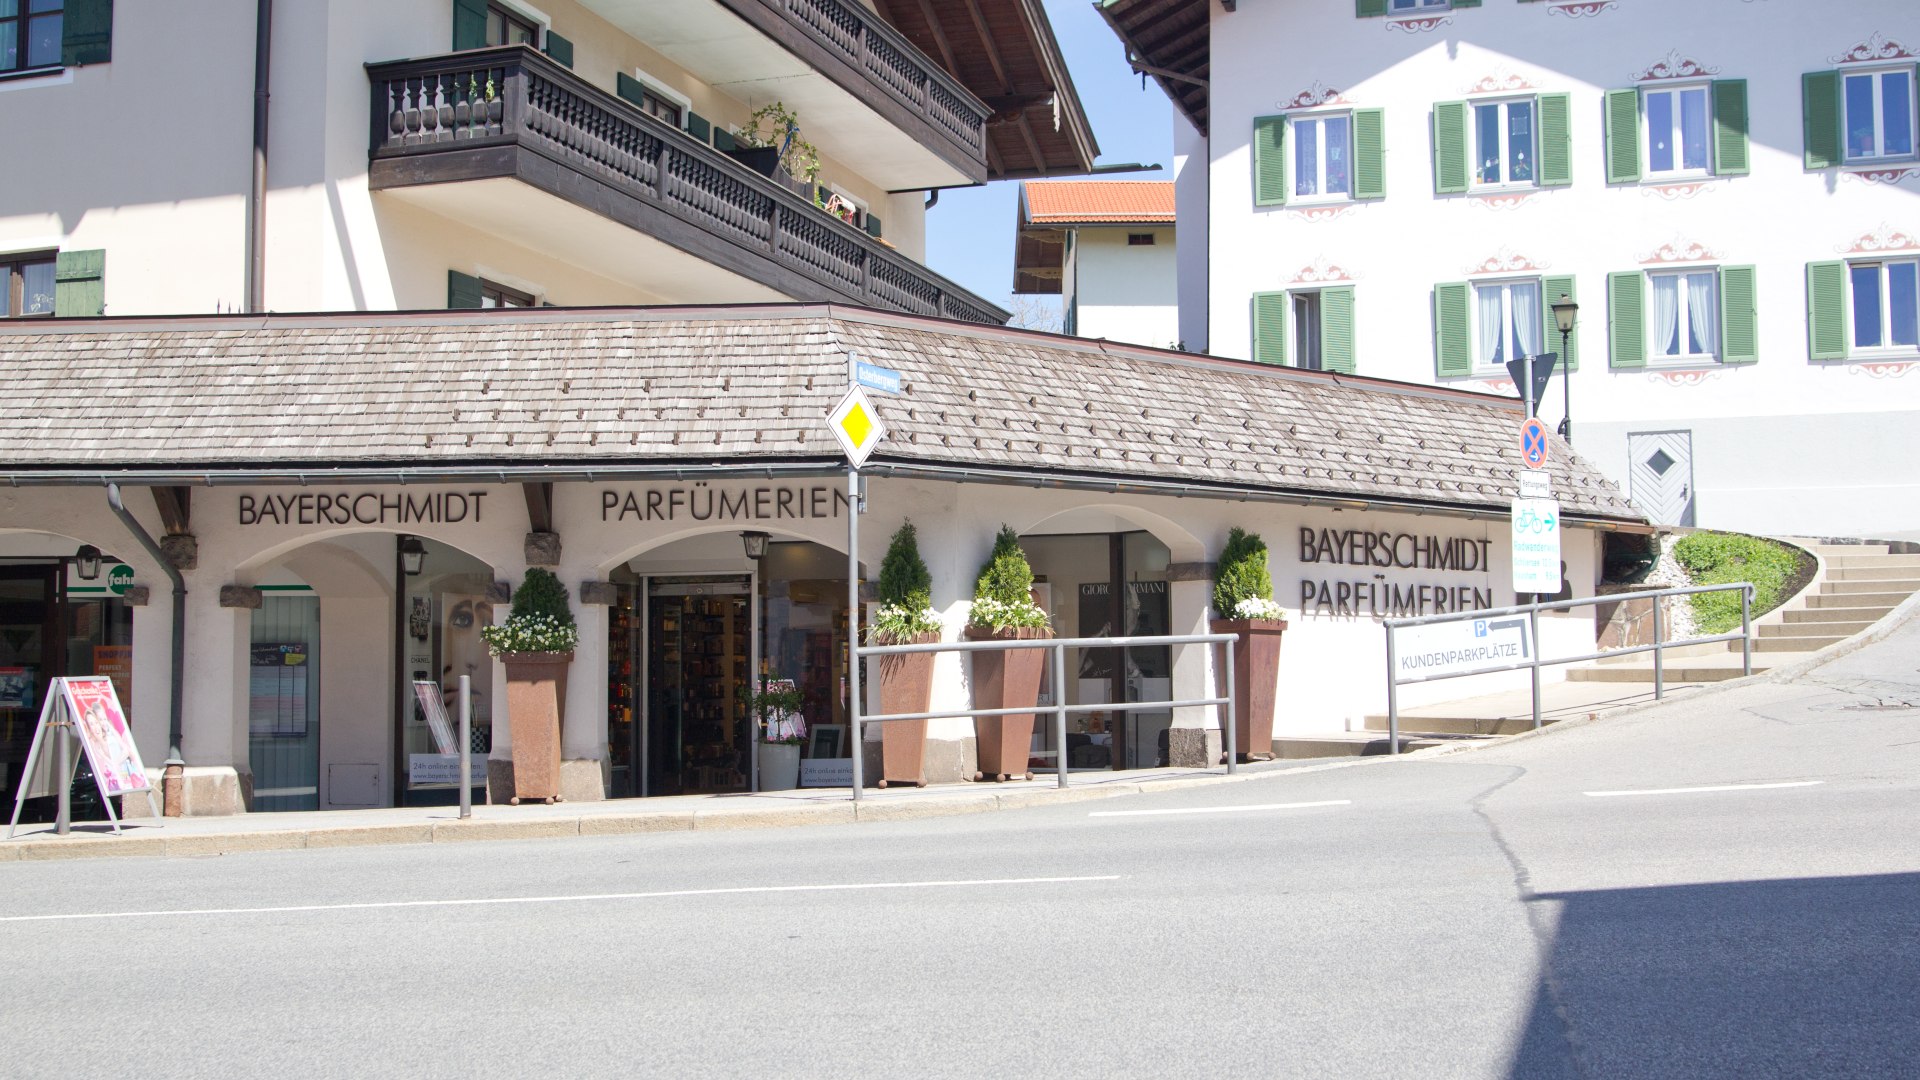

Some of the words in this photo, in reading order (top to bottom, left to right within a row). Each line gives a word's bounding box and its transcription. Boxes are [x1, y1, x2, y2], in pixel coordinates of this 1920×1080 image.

[239, 491, 487, 525] BAYERSCHMIDT
[1300, 527, 1492, 572] BAYERSCHMIDT
[1301, 573, 1492, 618] PARFÜMERIEN
[1402, 643, 1518, 670] KUNDENPARKPLÄTZE
[413, 762, 426, 770] 24h
[427, 762, 448, 770] online
